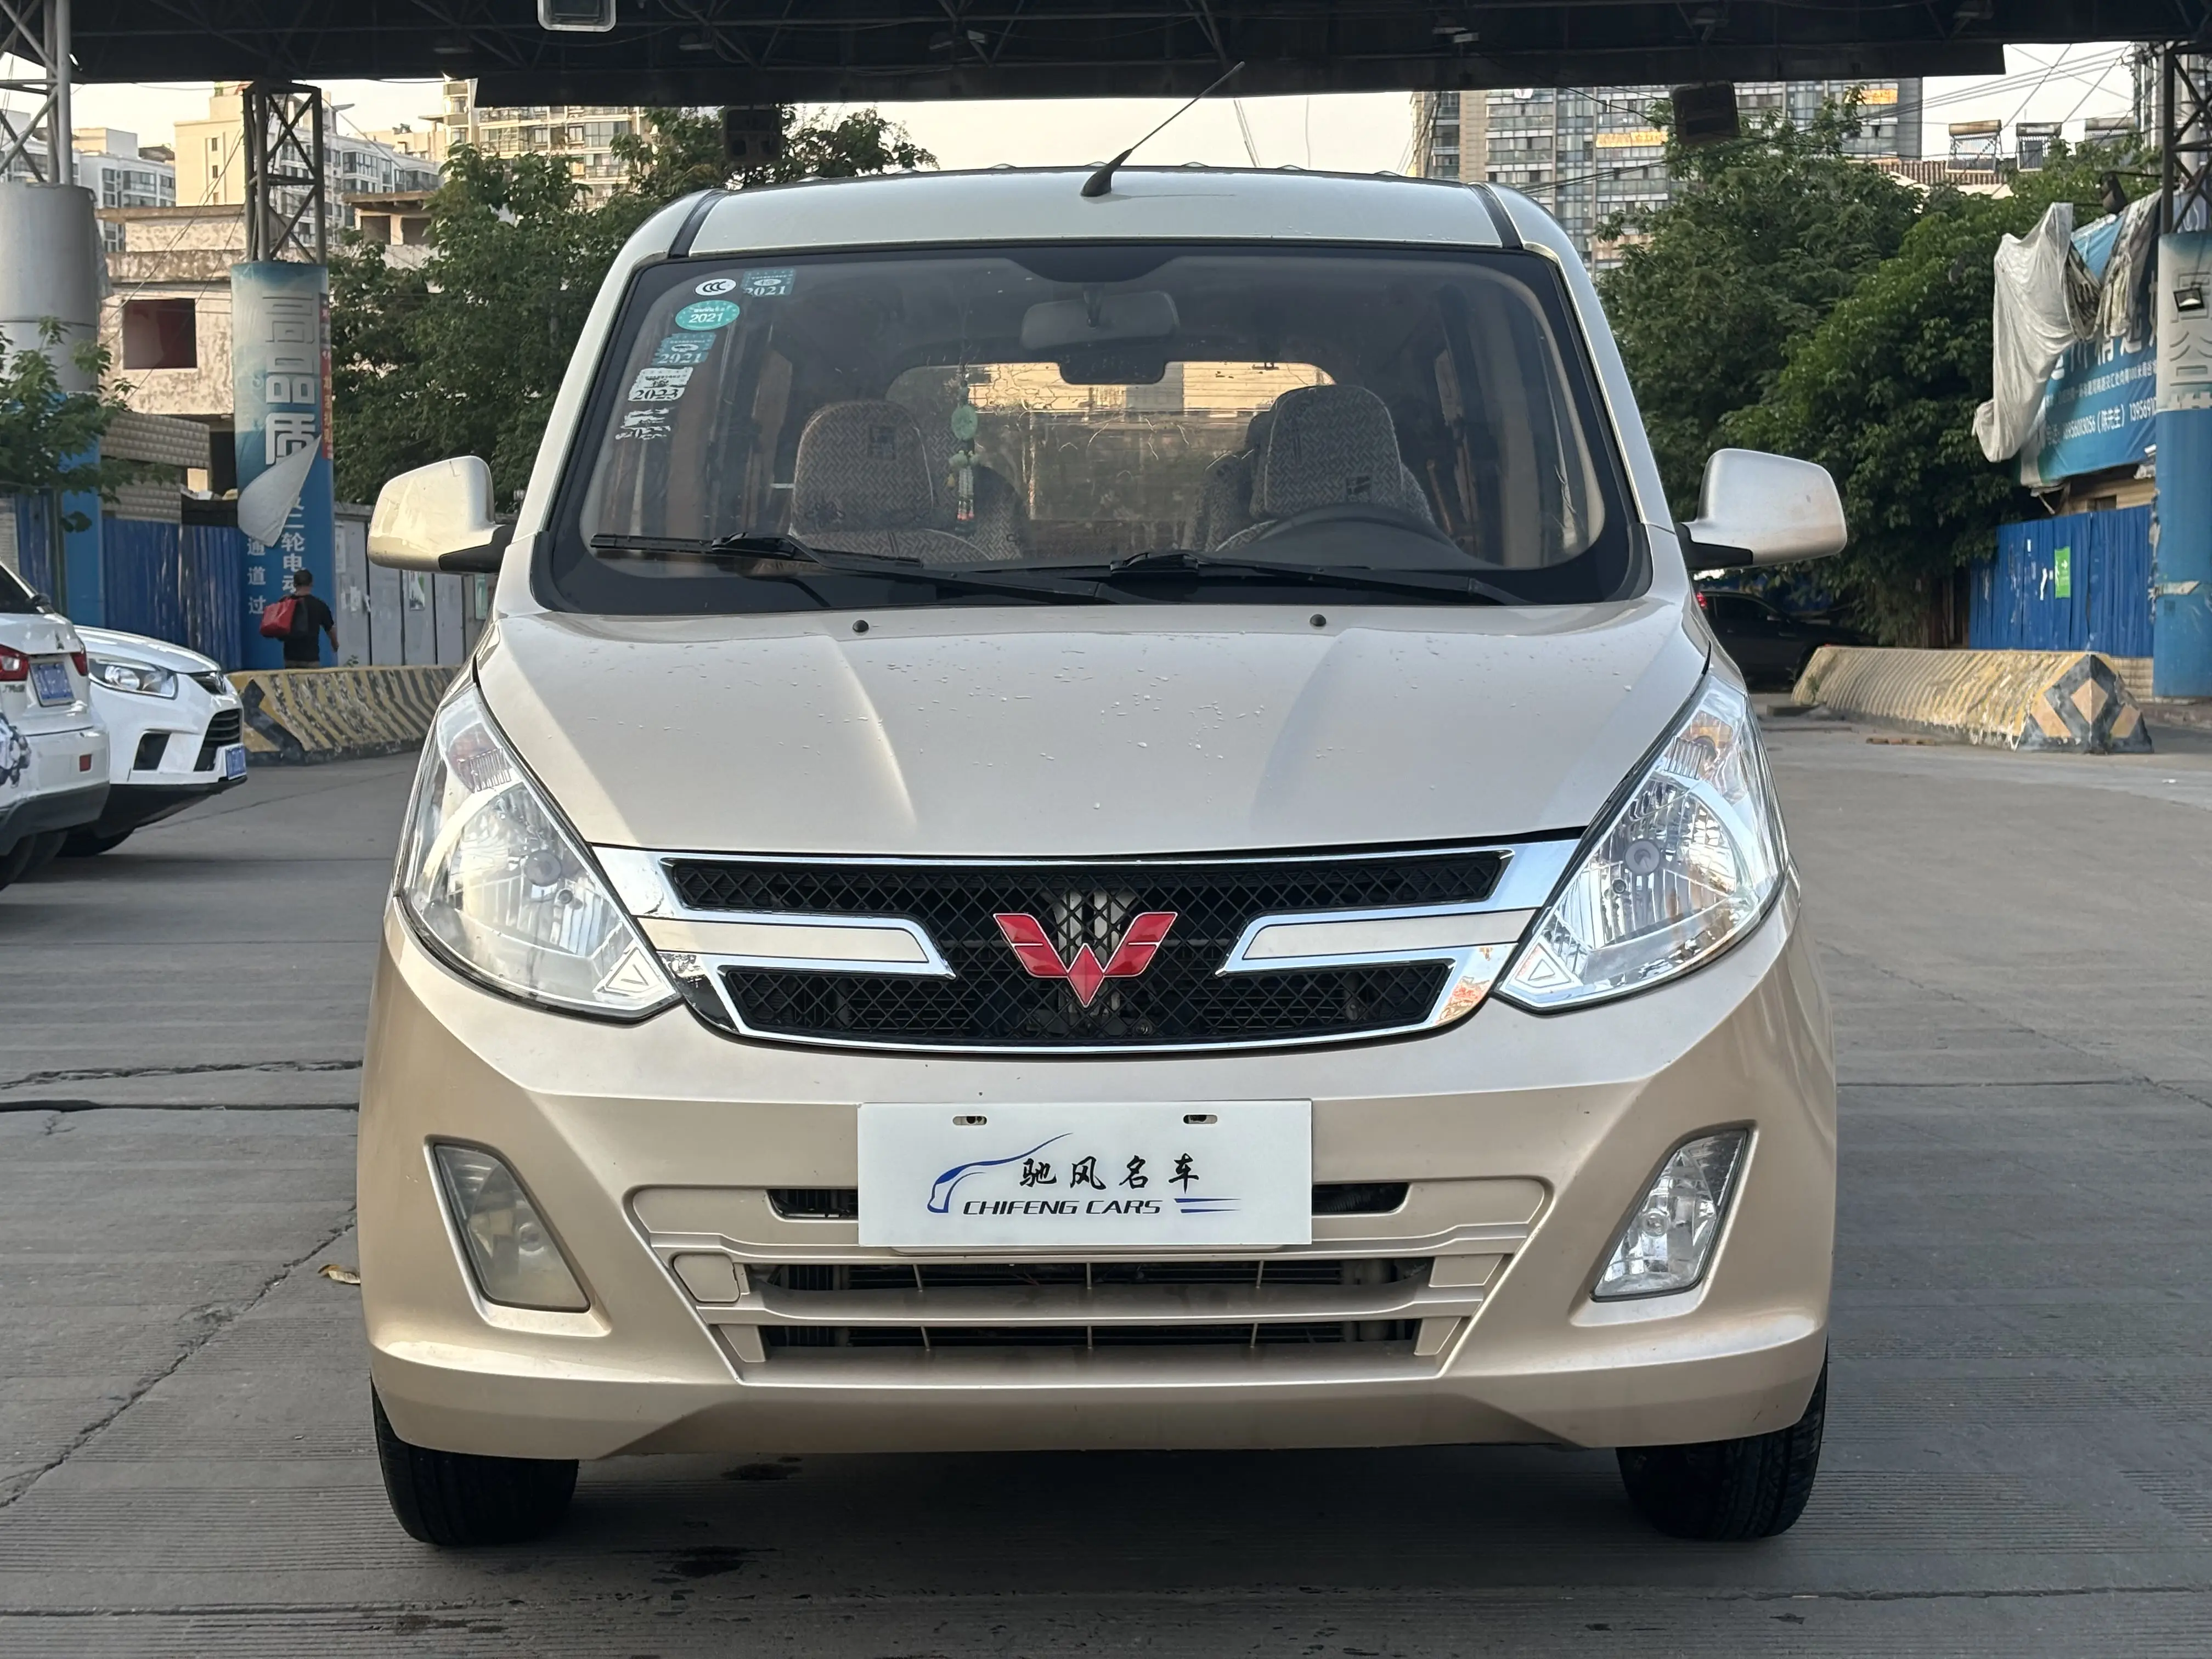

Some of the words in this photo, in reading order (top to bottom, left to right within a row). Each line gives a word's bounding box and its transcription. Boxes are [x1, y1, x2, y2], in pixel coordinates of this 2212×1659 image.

[702, 280, 727, 292] CCC
[743, 286, 786, 296] 2021
[689, 313, 723, 323] 2021
[657, 352, 702, 364] 2021
[633, 388, 679, 400] 2023
[1019, 1153, 1200, 1194] 驰风名车
[963, 1200, 1078, 1215] CHIFENG
[1085, 1200, 1161, 1215] CARS
